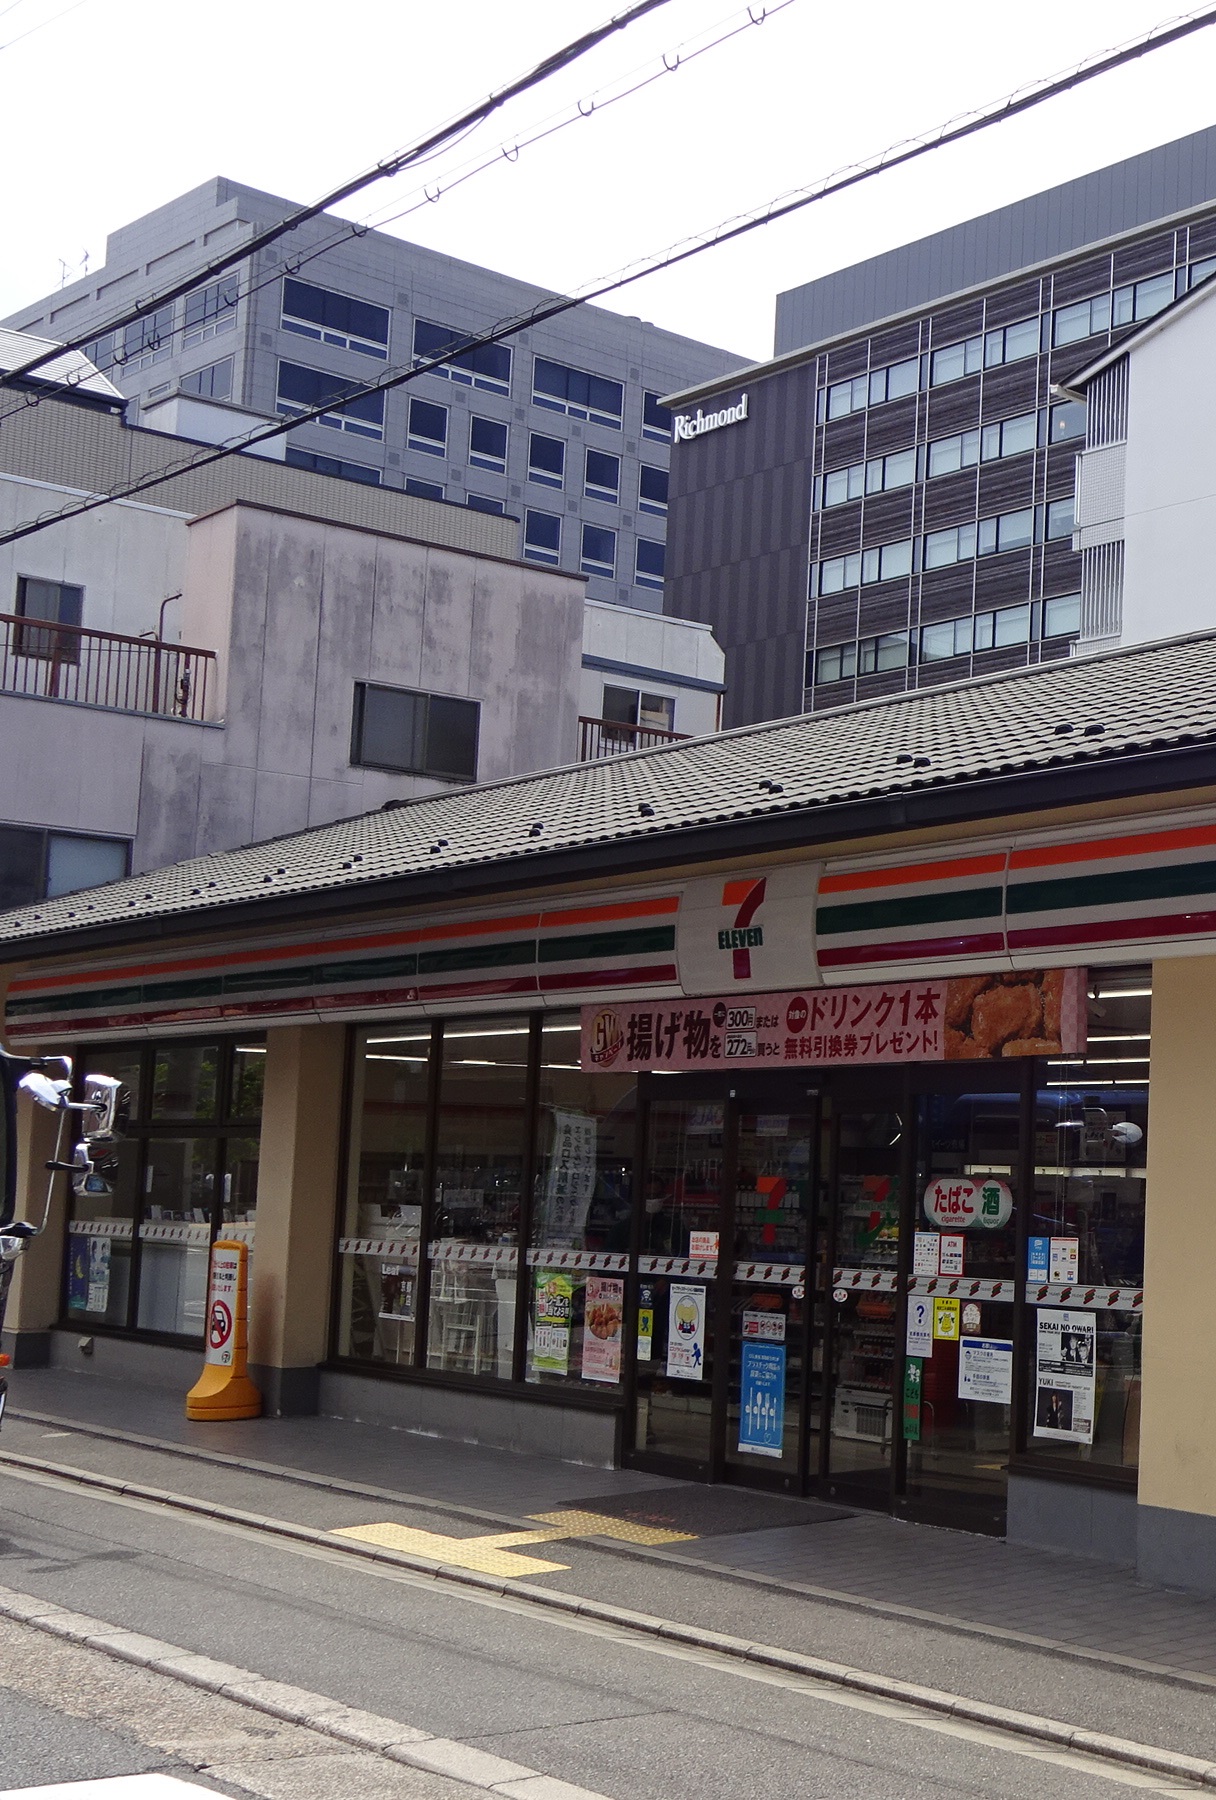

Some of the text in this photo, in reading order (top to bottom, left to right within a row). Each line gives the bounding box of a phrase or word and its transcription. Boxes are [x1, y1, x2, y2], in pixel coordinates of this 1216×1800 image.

[674, 393, 748, 443] Richmond
[810, 987, 941, 1031] ドリンク1本
[934, 1185, 1000, 1216] たばこ 酒
[382, 1263, 400, 1276] Leaf
[1039, 1321, 1094, 1334] SEKAI NO OWARI
[1038, 1378, 1054, 1386] YUKI
